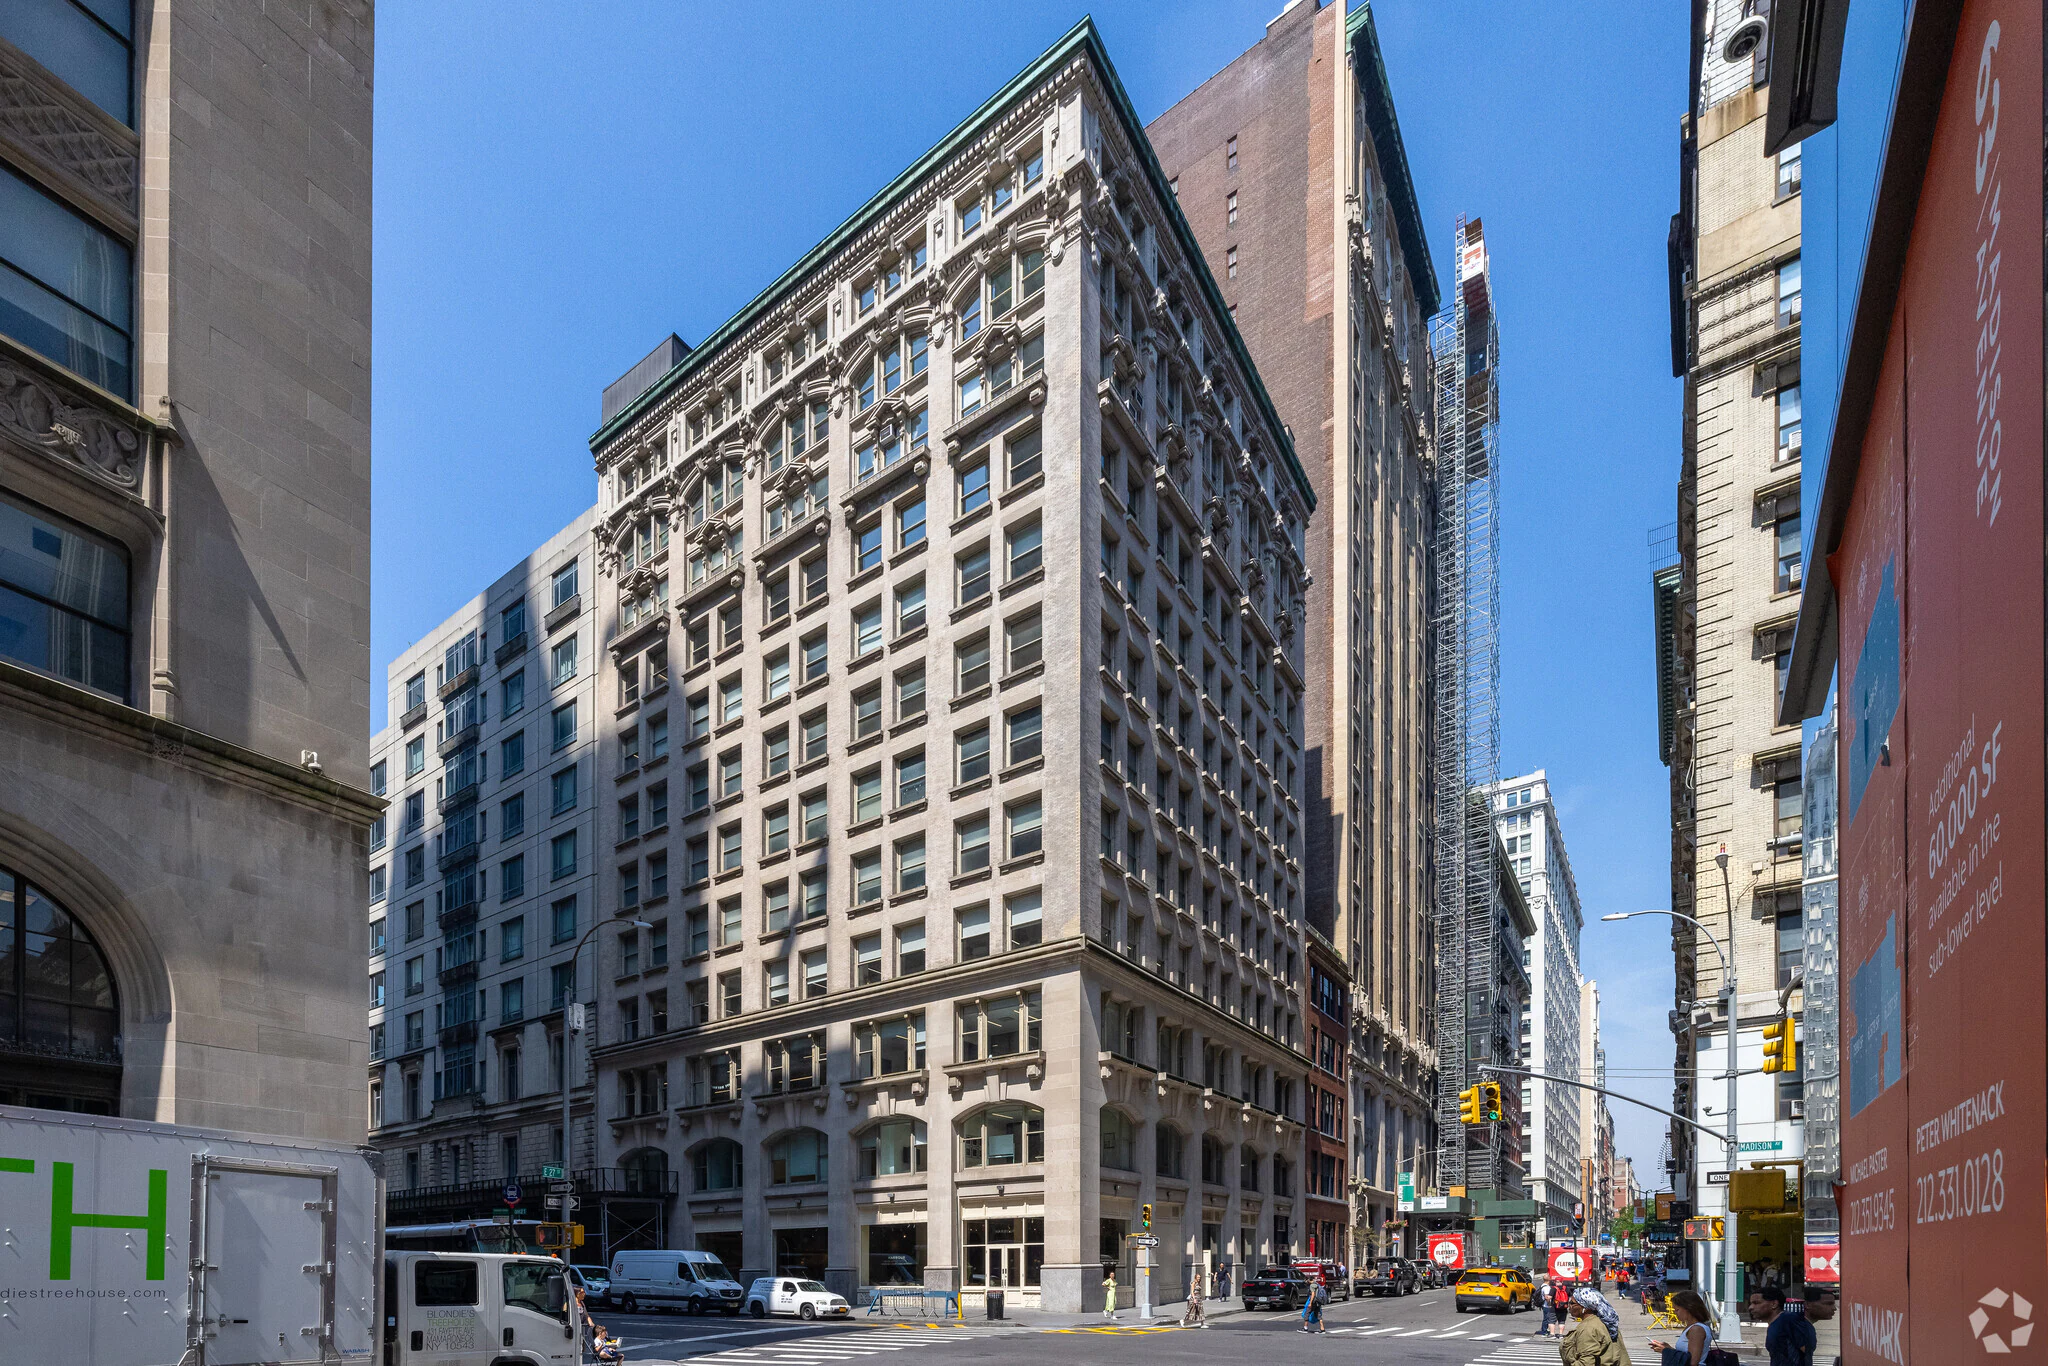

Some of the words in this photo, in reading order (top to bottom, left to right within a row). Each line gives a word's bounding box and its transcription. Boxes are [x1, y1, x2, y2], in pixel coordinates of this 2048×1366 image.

[1976, 239, 1988, 518] AVENUE
[1989, 180, 2001, 528] MADISON
[1928, 712, 1975, 825] Additional
[1928, 765, 1978, 879] 60,000
[1981, 720, 2002, 798] SF
[1928, 859, 1967, 931] available
[1968, 843, 1979, 877] in
[1981, 812, 2000, 860] the
[1928, 904, 1974, 978] sub-lower
[1976, 860, 2003, 925] level
[1916, 1117, 1940, 1154] PETER
[1941, 1080, 2005, 1142] WHITENACK
[1740, 1142, 1772, 1151] MADISON
[1850, 1155, 1868, 1185] MICHAEL
[1869, 1147, 1888, 1175] PASTER
[543, 1168, 548, 1176] E
[549, 1168, 556, 1177] 27
[1916, 1148, 2005, 1224] 212.331.0128
[0, 1287, 167, 1299] diestreehouse.com
[427, 1309, 475, 1318] BLONDIE'S
[426, 1334, 475, 1343] MAMARONECK
[426, 1342, 442, 1351] NY
[445, 1342, 475, 1350] 10543
[427, 1318, 475, 1326] TREEHOUSE
[438, 1327, 463, 1335] FAYETTE
[464, 1327, 474, 1335] AVE
[1850, 1302, 1904, 1366] NEWMARK
